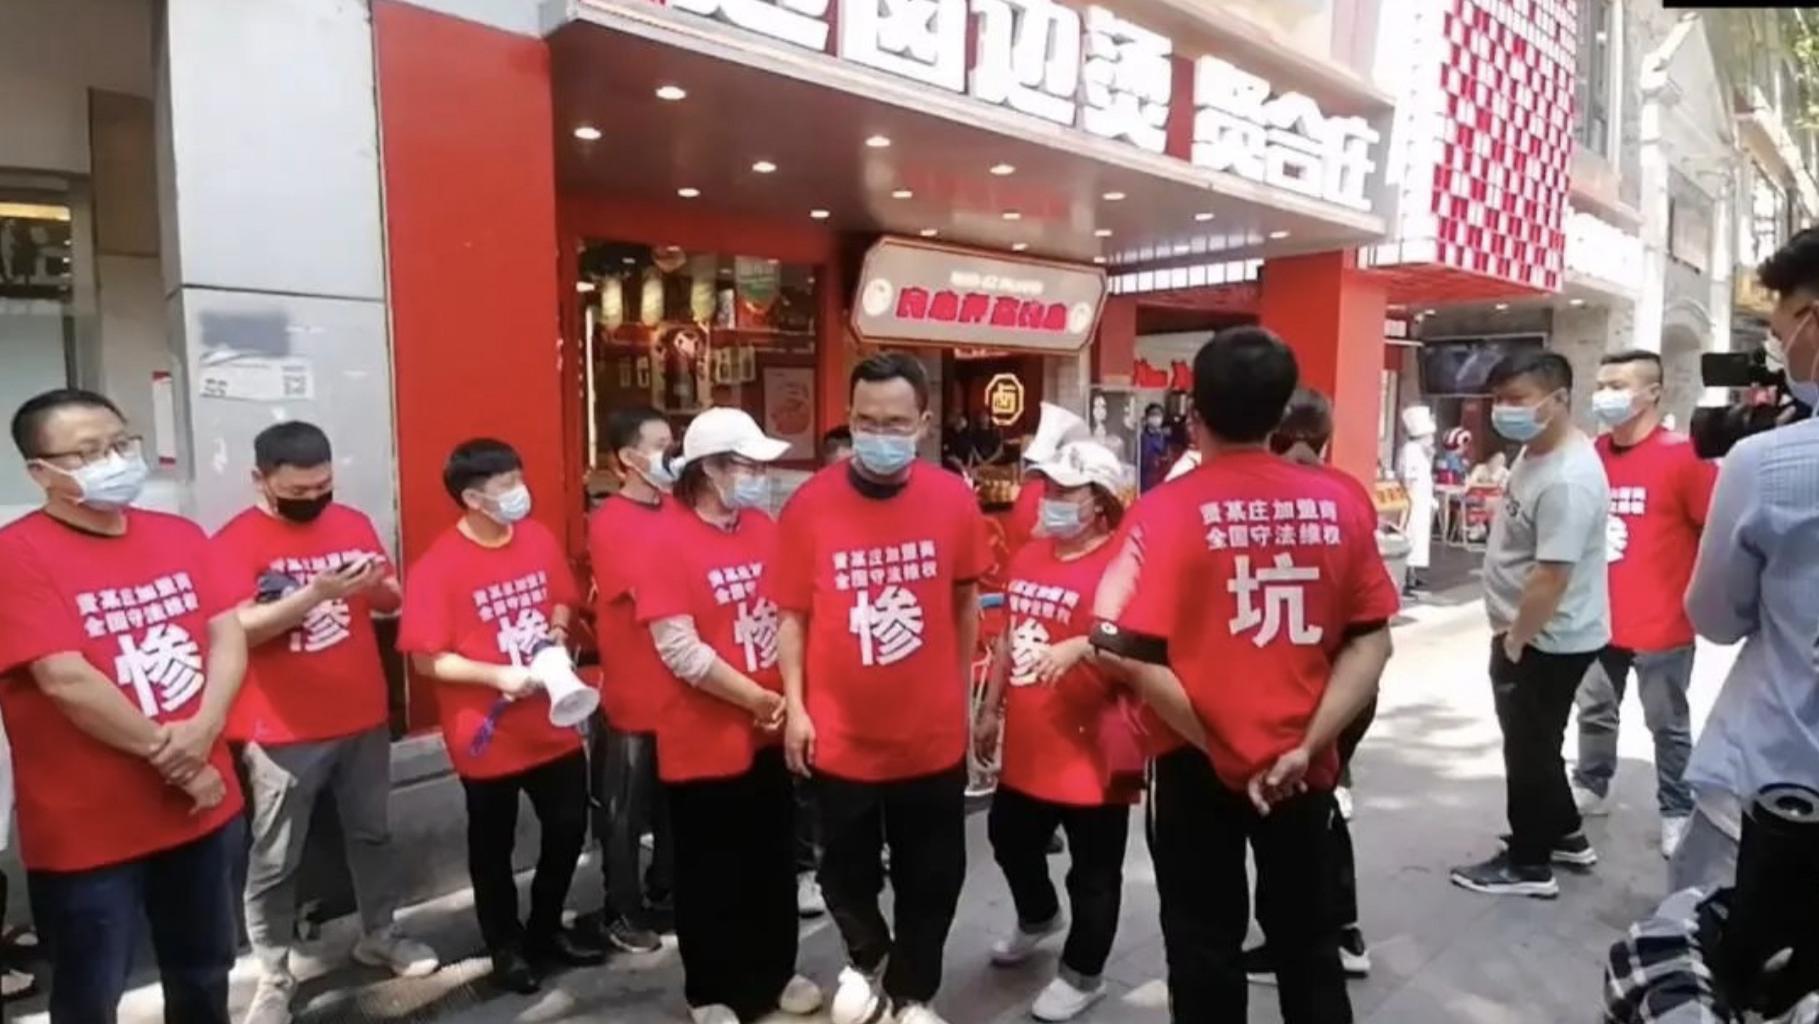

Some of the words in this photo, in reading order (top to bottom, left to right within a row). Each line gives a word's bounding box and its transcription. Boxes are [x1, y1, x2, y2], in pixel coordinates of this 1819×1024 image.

[1192, 54, 1380, 210] 贤合庄
[834, 561, 937, 590] 全国守法维权
[1206, 524, 1342, 550] 全国守法维权
[496, 608, 549, 667] 惨
[734, 597, 779, 672] 惨
[849, 584, 925, 667] 惨
[1227, 552, 1324, 648] 坑
[114, 622, 204, 718] 惨
